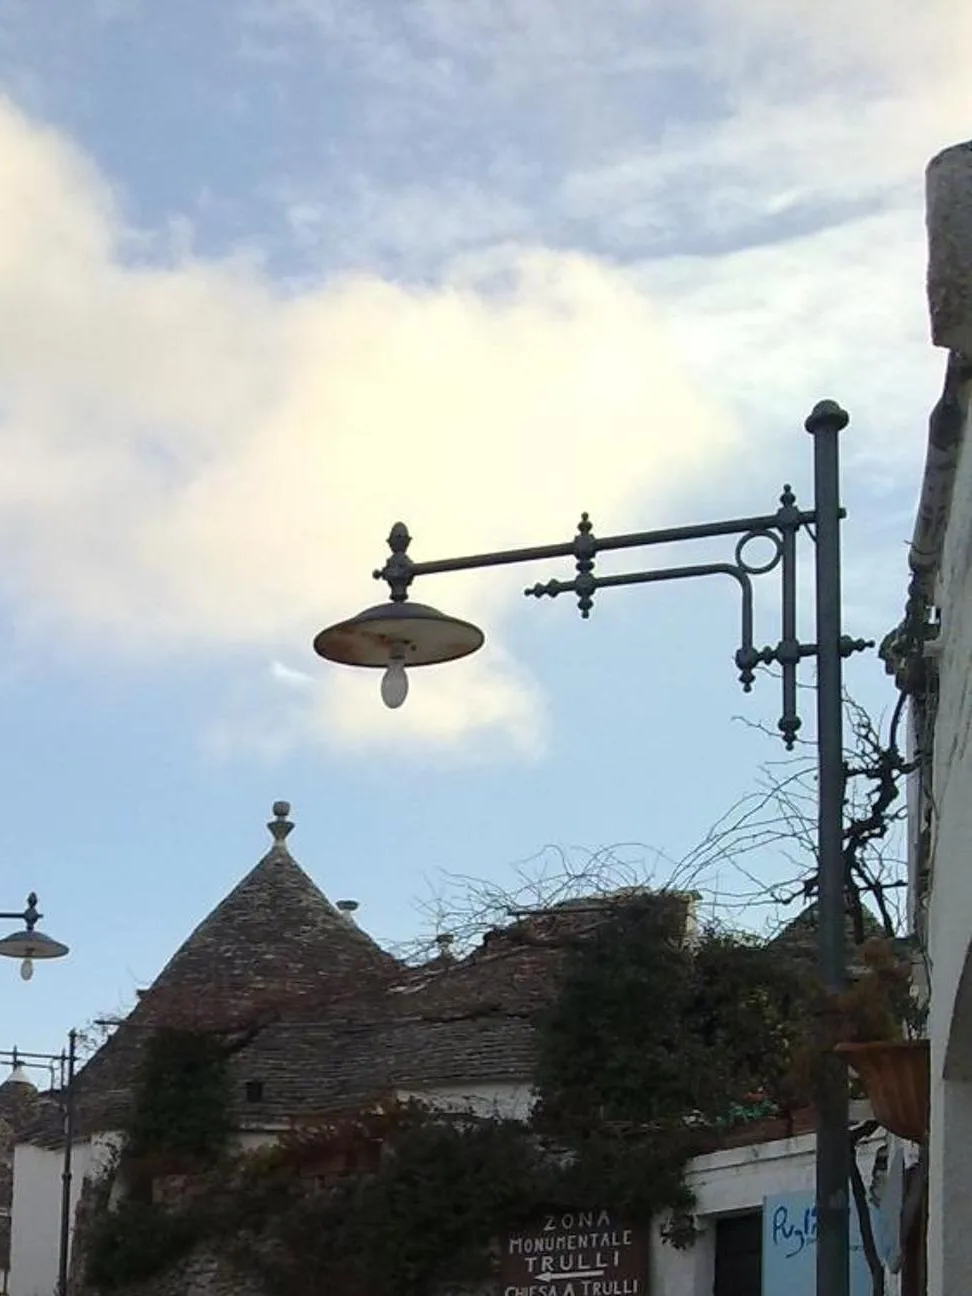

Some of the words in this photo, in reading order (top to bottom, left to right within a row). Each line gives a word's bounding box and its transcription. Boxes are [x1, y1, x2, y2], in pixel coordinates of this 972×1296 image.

[542, 1209, 611, 1232] ZONA
[772, 1205, 817, 1259] Pugli
[509, 1229, 633, 1255] MONUMENTALE
[524, 1250, 620, 1273] TRULLI
